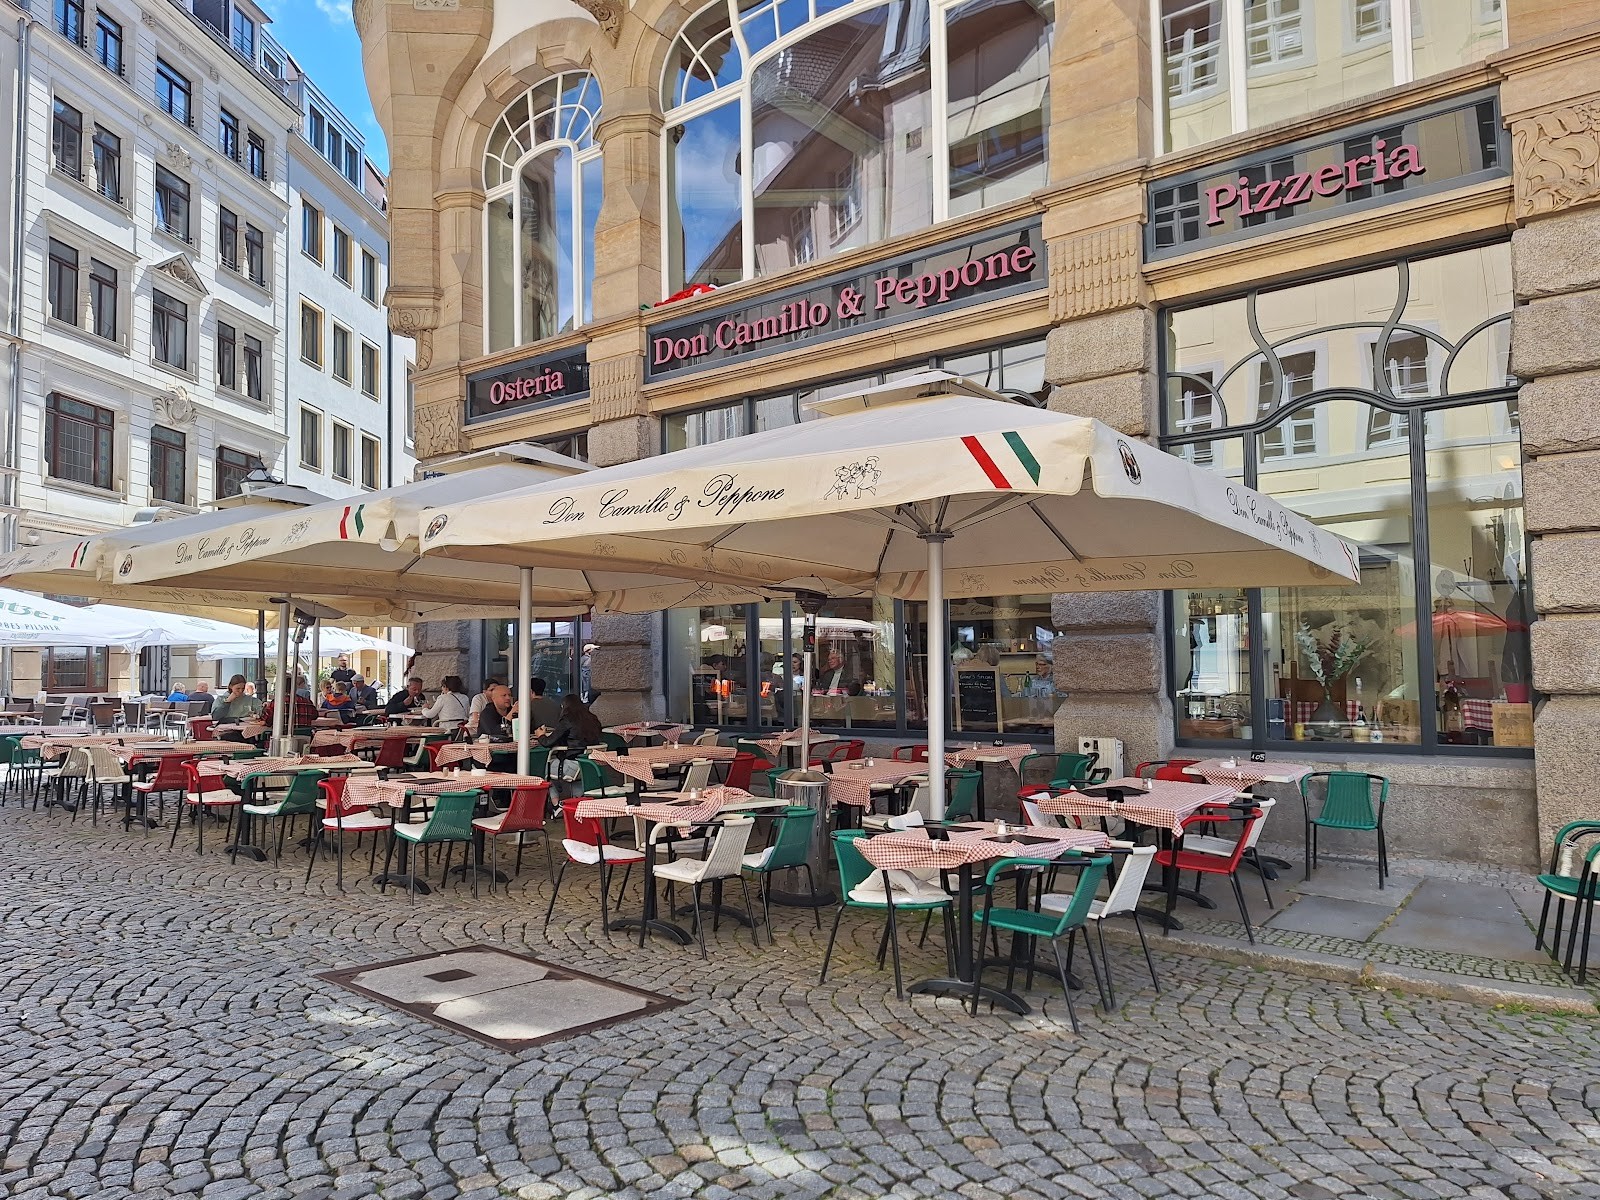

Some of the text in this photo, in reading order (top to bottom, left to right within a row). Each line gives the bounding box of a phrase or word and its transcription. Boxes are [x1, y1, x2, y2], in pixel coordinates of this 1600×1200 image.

[1206, 139, 1424, 226] Pizzeria
[653, 245, 1036, 365] Don Camillo & Peppone
[489, 367, 566, 405] Osteria
[543, 473, 785, 525] Don Camillo & Peppone
[1226, 486, 1249, 516] Don
[1246, 495, 1276, 531] Camillo
[1280, 510, 1305, 547] Peppone
[175, 527, 271, 565] Don Camillo & Peppone
[24, 623, 61, 631] PILSNER
[1251, 753, 1265, 761] 105
